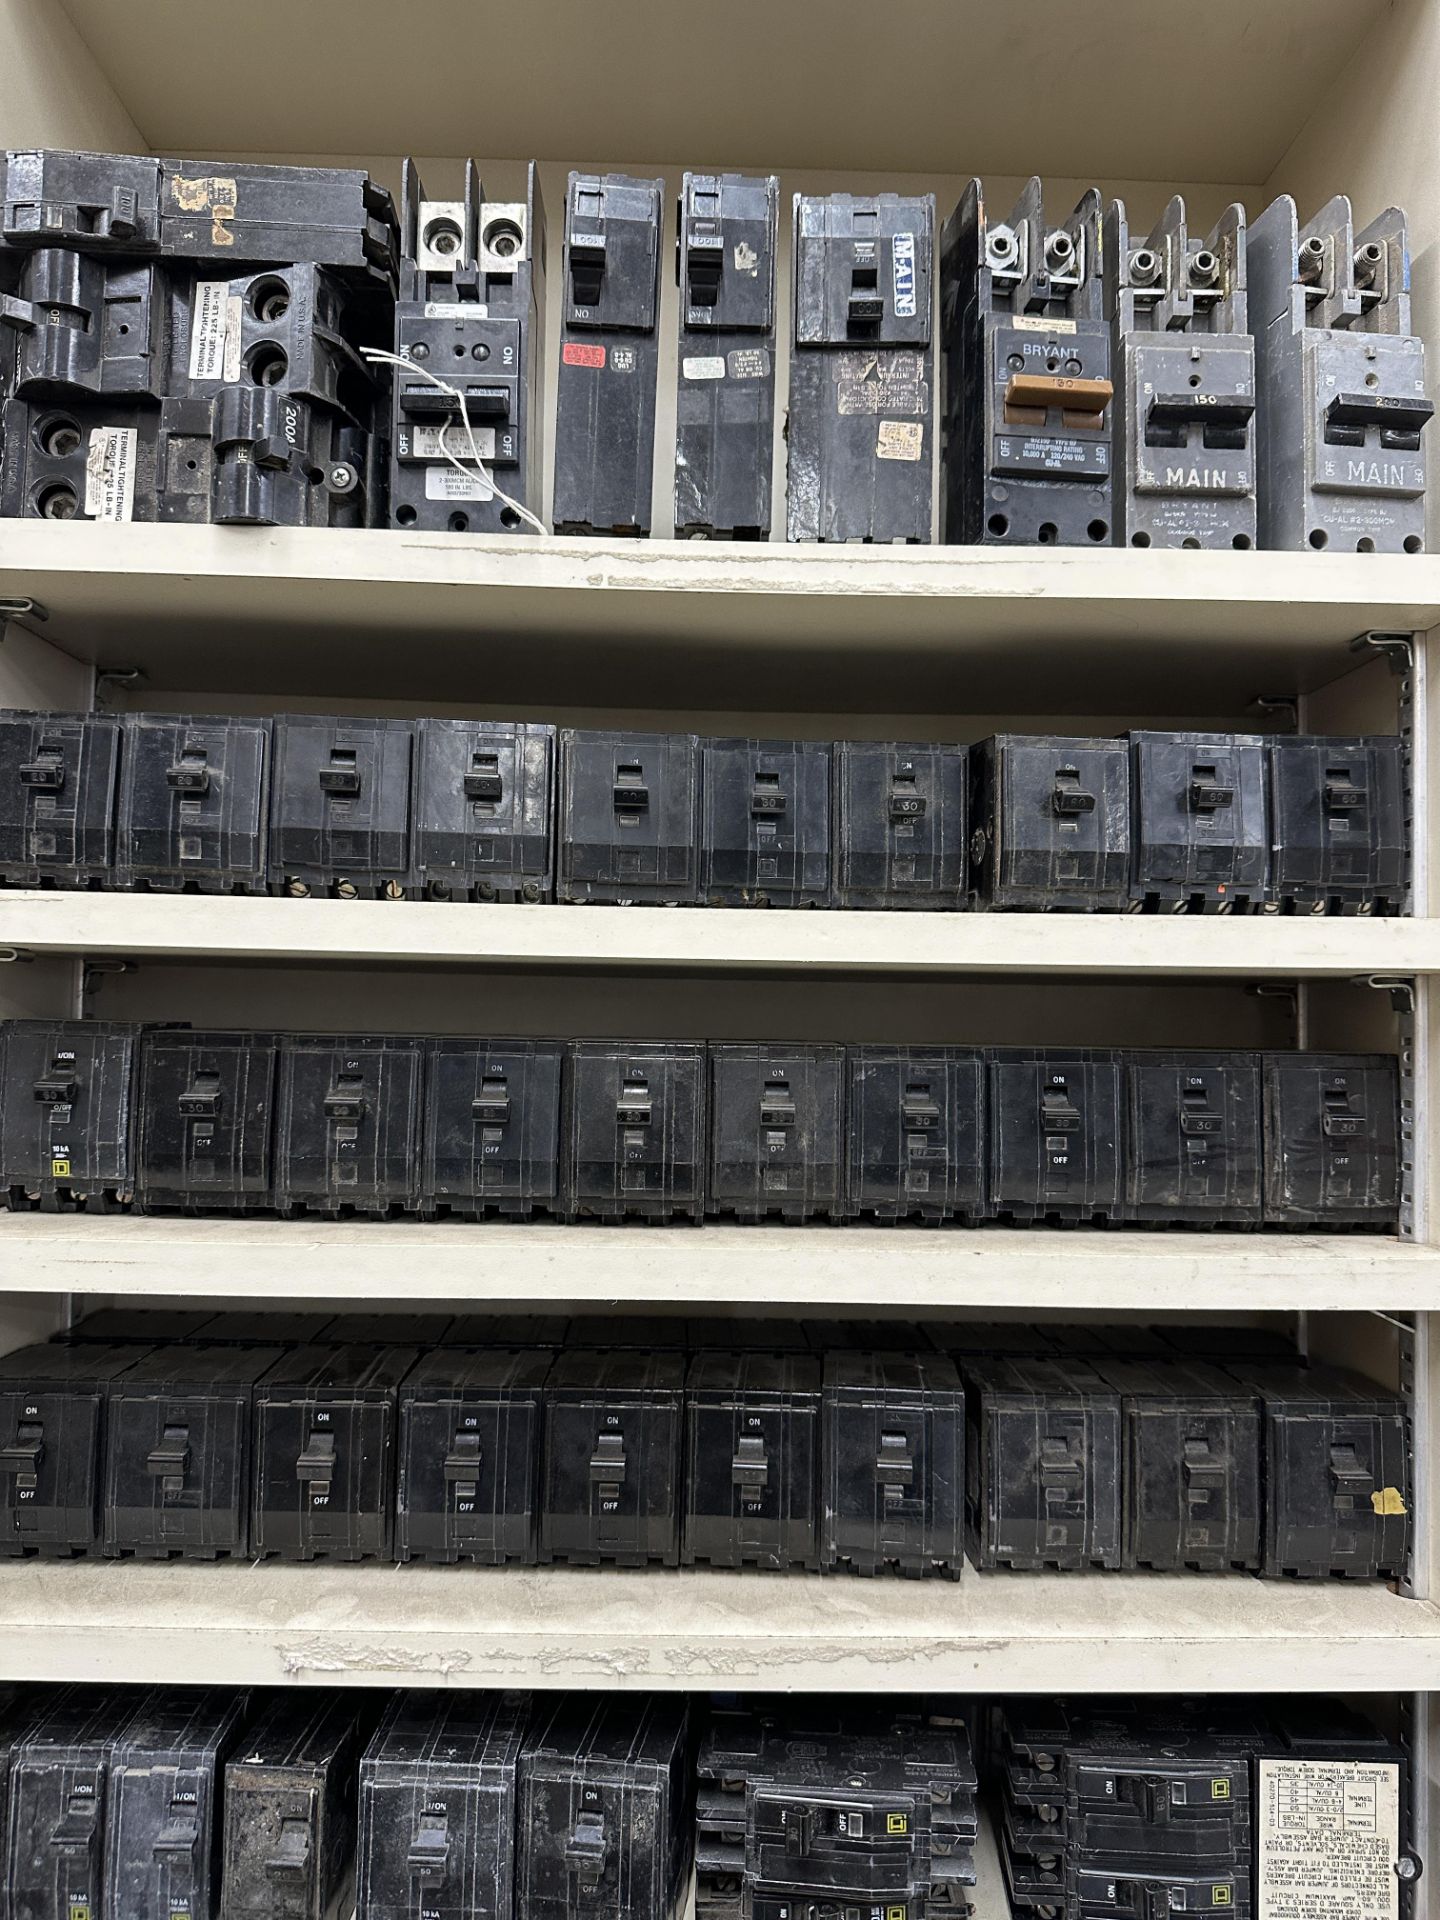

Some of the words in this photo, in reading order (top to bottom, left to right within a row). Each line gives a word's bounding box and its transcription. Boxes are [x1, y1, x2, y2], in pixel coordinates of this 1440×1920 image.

[200, 286, 211, 336] TIGHTENING
[575, 309, 589, 318] ON
[210, 318, 218, 334] 225
[207, 336, 217, 374] TORQUE:
[503, 347, 513, 364] ON
[1023, 344, 1079, 358] BRYANT
[196, 336, 207, 378] TERMINAL
[1194, 395, 1217, 404] 150
[1376, 396, 1400, 408] 200
[285, 406, 296, 444] 200A
[400, 434, 408, 454] OFF
[503, 436, 512, 456] OFF
[1001, 440, 1010, 457] OFF
[118, 430, 129, 472] TERMINAL
[1096, 446, 1106, 464] OFF
[1166, 467, 1226, 488] MAIN
[1348, 460, 1404, 485] MAIN
[115, 471, 126, 522] TIGHTENING
[105, 491, 114, 516] LB-IN
[177, 776, 192, 786] 20
[761, 798, 776, 808] 30
[902, 802, 918, 812] 30
[492, 1064, 503, 1072] ON
[1053, 1076, 1064, 1084] ON
[188, 1104, 204, 1112] 30
[1196, 1121, 1212, 1130] 30
[1341, 1123, 1356, 1132] 30
[485, 1146, 500, 1154] OFF
[1053, 1156, 1068, 1164] OFF
[465, 1418, 476, 1426] ON
[606, 1416, 618, 1424] ON
[748, 1418, 760, 1426] ON
[314, 1496, 329, 1504] OFF
[603, 1502, 618, 1510] OFF
[1106, 1780, 1113, 1794] ON
[586, 1792, 598, 1800] ON
[839, 1813, 847, 1832] OFF
[582, 1884, 598, 1893] OFF
[1108, 1884, 1115, 1898] ON
[430, 1910, 440, 1918] kA
